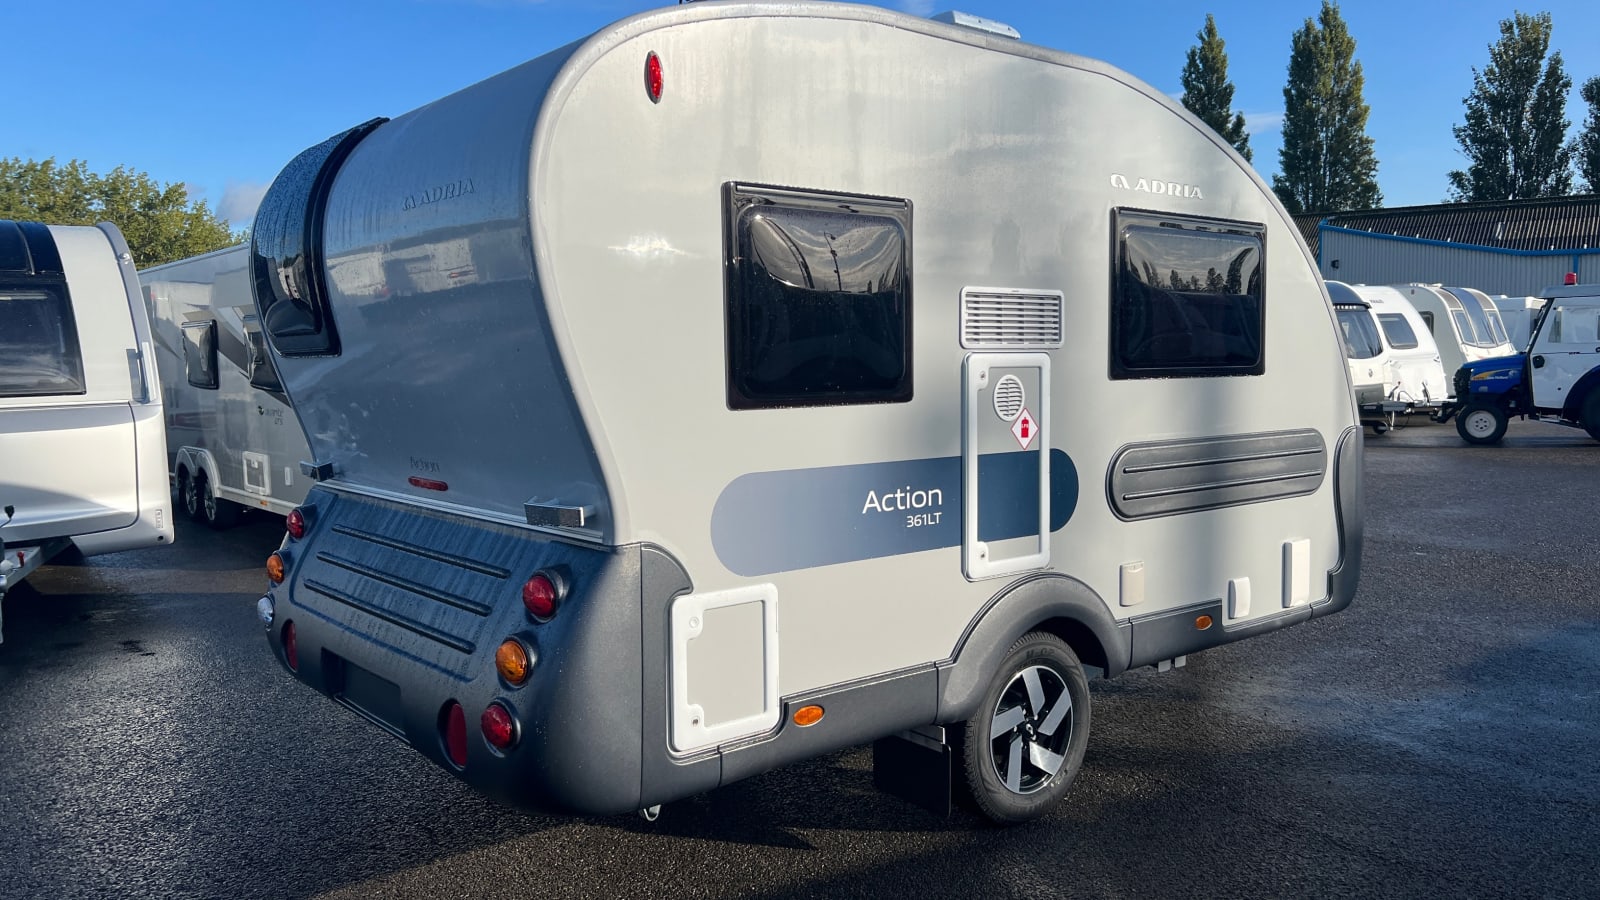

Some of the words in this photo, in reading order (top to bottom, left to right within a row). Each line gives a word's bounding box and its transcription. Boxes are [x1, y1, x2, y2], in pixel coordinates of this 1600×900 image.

[420, 177, 475, 205] ADRIA
[1134, 177, 1204, 200] ADRIA
[862, 485, 943, 514] Action
[906, 512, 942, 528] 361LT
